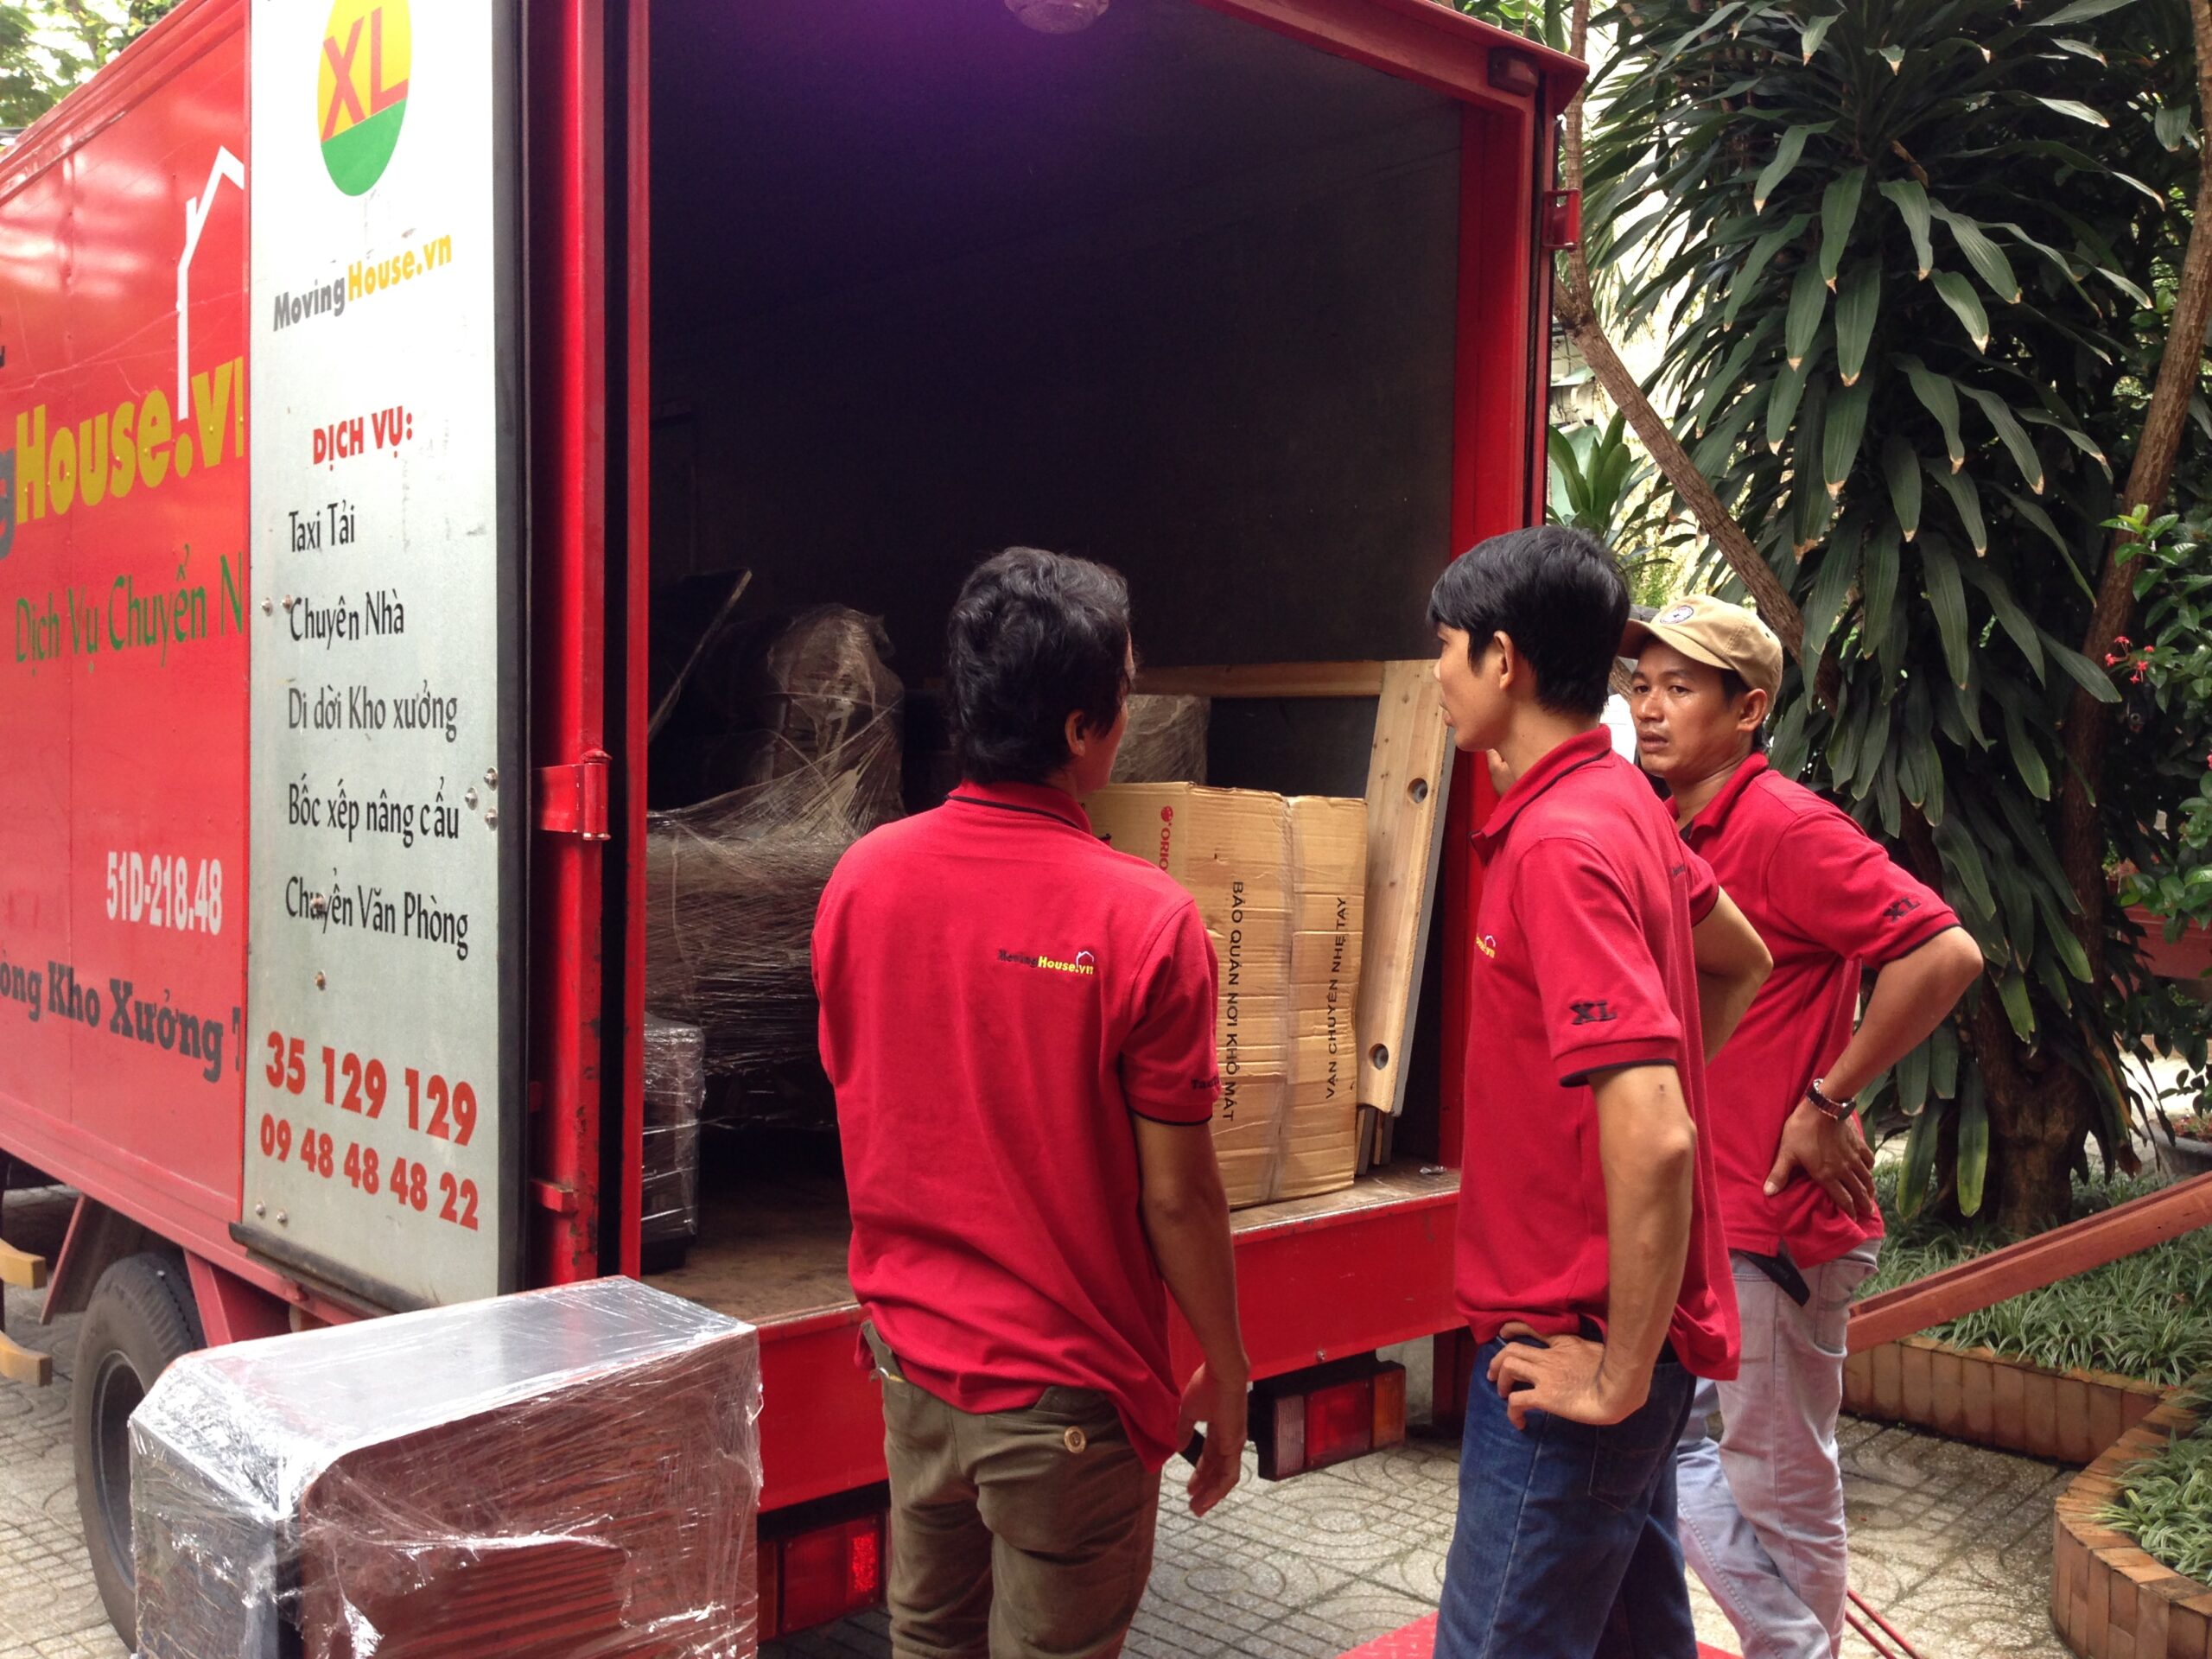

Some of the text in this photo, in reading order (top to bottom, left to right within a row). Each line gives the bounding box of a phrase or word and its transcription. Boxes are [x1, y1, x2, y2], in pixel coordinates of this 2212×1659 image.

[321, 6, 409, 143] XL
[273, 234, 452, 332] MovingHouse.vn
[313, 405, 413, 472] DỊCH VỤ:
[289, 499, 355, 552] Taxi Tải
[16, 593, 60, 677] Dịch
[67, 586, 99, 674] Vụ
[108, 543, 206, 668] Chuyển
[289, 588, 404, 650] Chuyên Nhà
[288, 679, 458, 743] Di dời Kho xưởng
[289, 773, 459, 849] Bốc xếp nâng cẩu
[1159, 827, 1171, 872] ORIO
[106, 851, 223, 936] 51D-218.48
[286, 867, 468, 961] Chuyển Văn Phòng
[1336, 897, 1346, 931] TAY
[1883, 898, 1921, 923] XL
[48, 960, 101, 1028] Kho
[109, 978, 224, 1084] Xưởng
[1569, 1000, 1618, 1025] XL
[1226, 1033, 1240, 1075] KHÔ
[266, 1031, 306, 1096] 35
[321, 1046, 387, 1119] 129
[404, 1067, 477, 1147] 129
[1223, 1082, 1237, 1122] MÁT
[261, 1113, 478, 1231] 09 48 48 48 22
